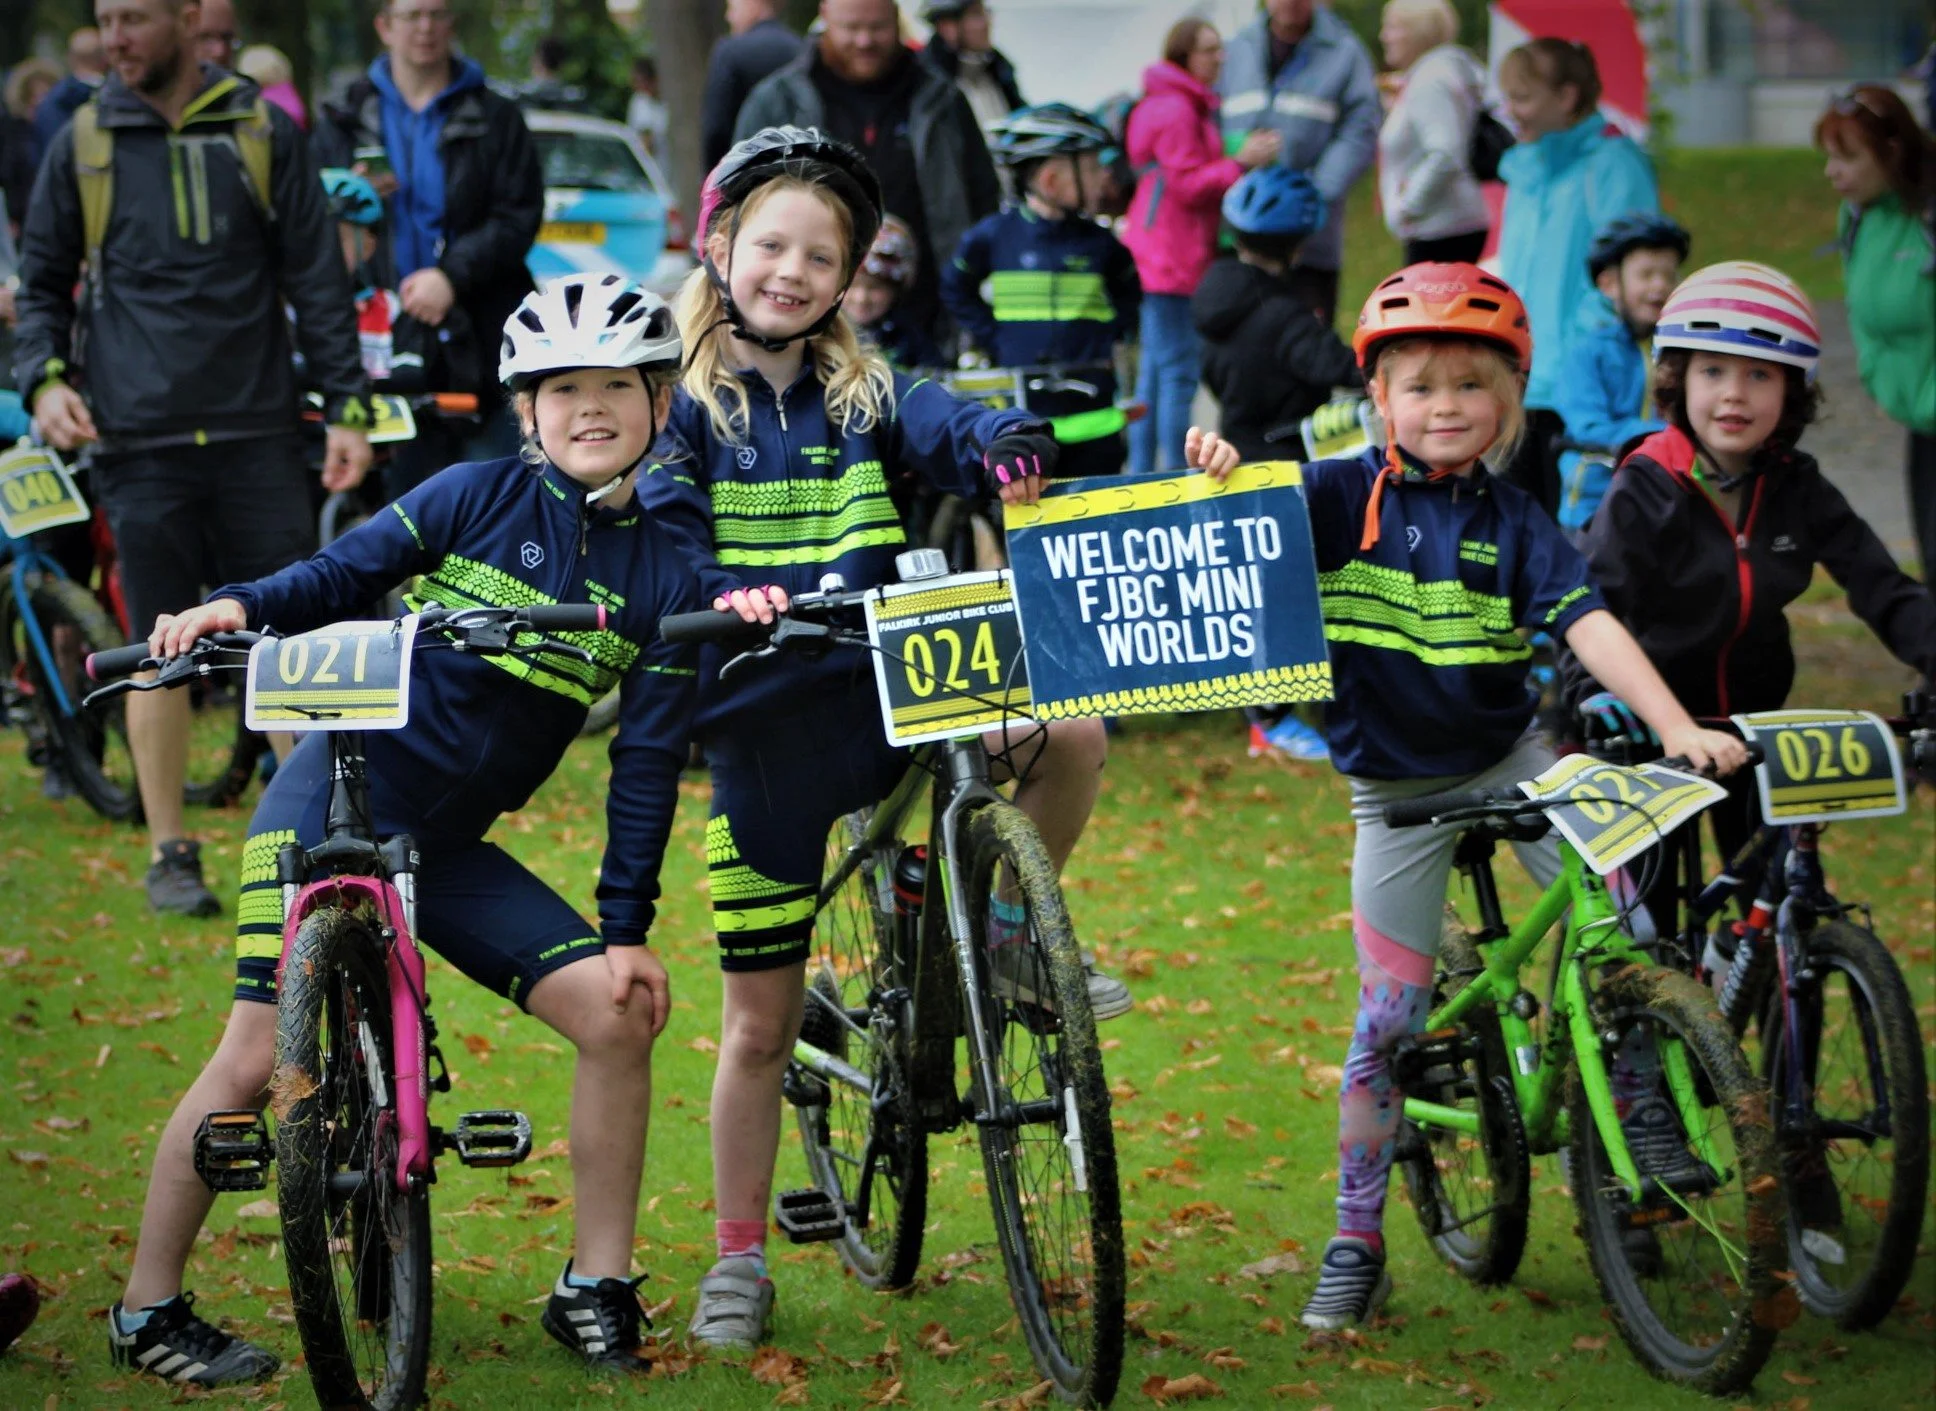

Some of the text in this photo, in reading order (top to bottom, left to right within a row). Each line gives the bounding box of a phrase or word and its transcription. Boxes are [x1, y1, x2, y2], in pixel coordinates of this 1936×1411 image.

[3, 471, 62, 512] 040
[1041, 515, 1282, 580] WELCOME TO
[878, 602, 1013, 632] FALKIRK JUNIOR BIKE CLUB
[1076, 565, 1263, 623] FJBC MINI
[904, 621, 1000, 697] 024
[1097, 614, 1255, 668] WORLDS
[1776, 726, 1871, 782] 026
